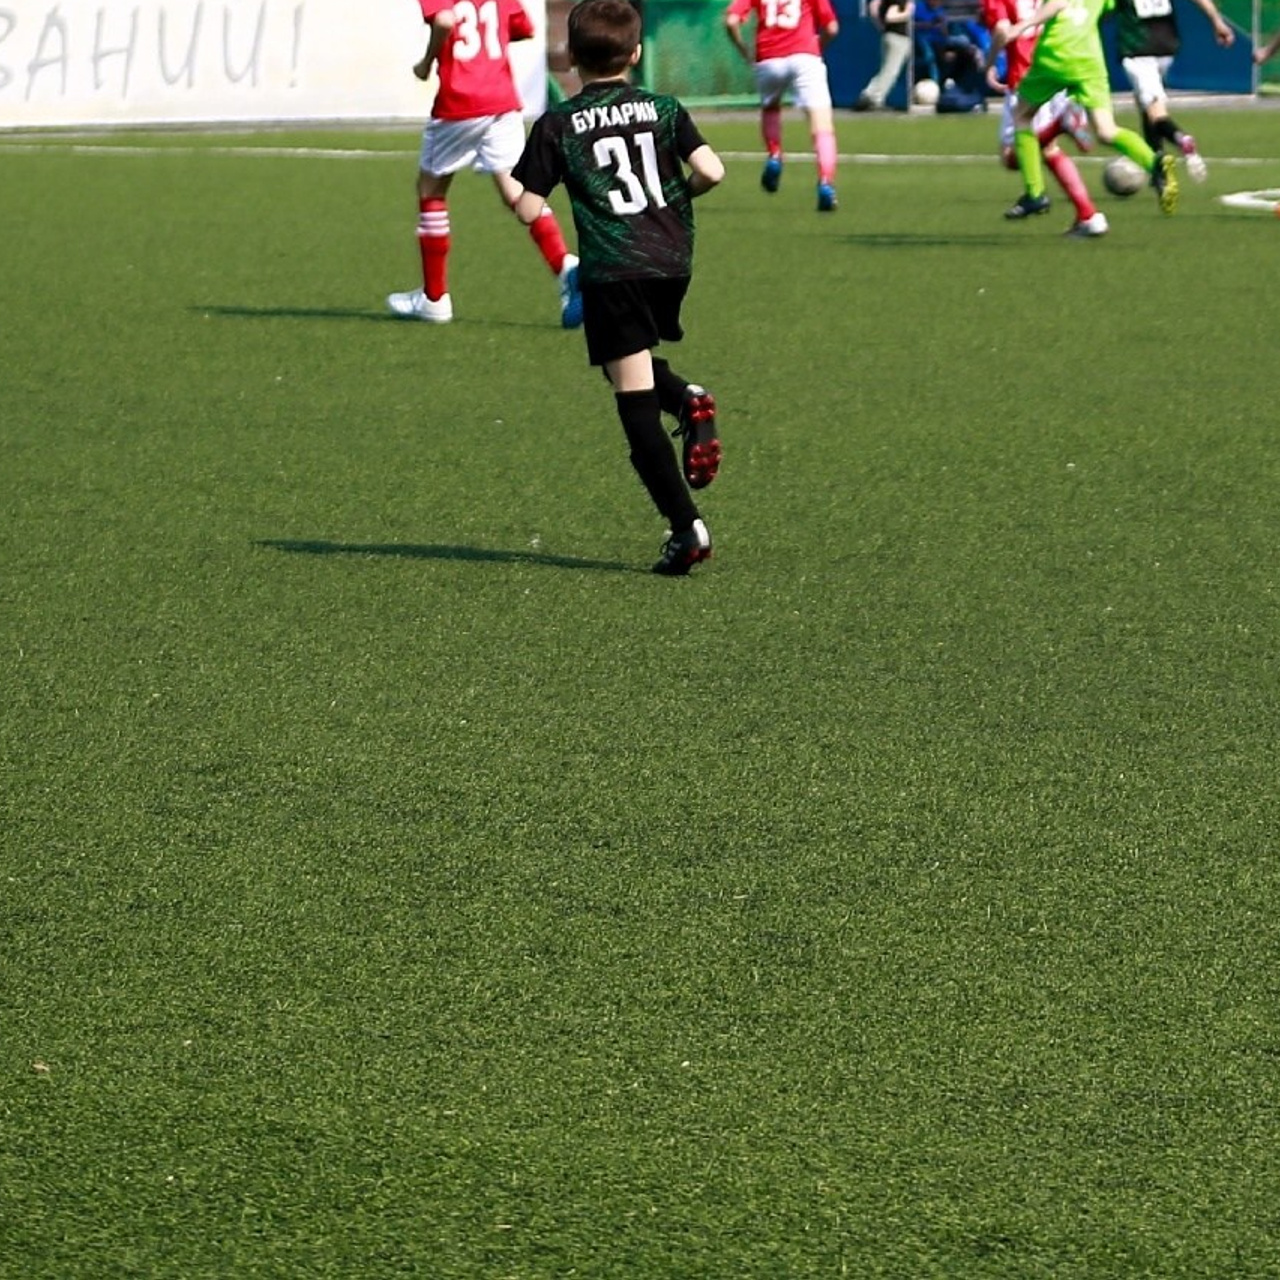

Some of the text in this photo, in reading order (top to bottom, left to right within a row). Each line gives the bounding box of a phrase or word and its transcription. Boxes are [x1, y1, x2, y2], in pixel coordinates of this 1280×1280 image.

[452, 0, 503, 62] 31
[571, 100, 659, 135] БУХАРИН
[593, 131, 668, 215] 31
